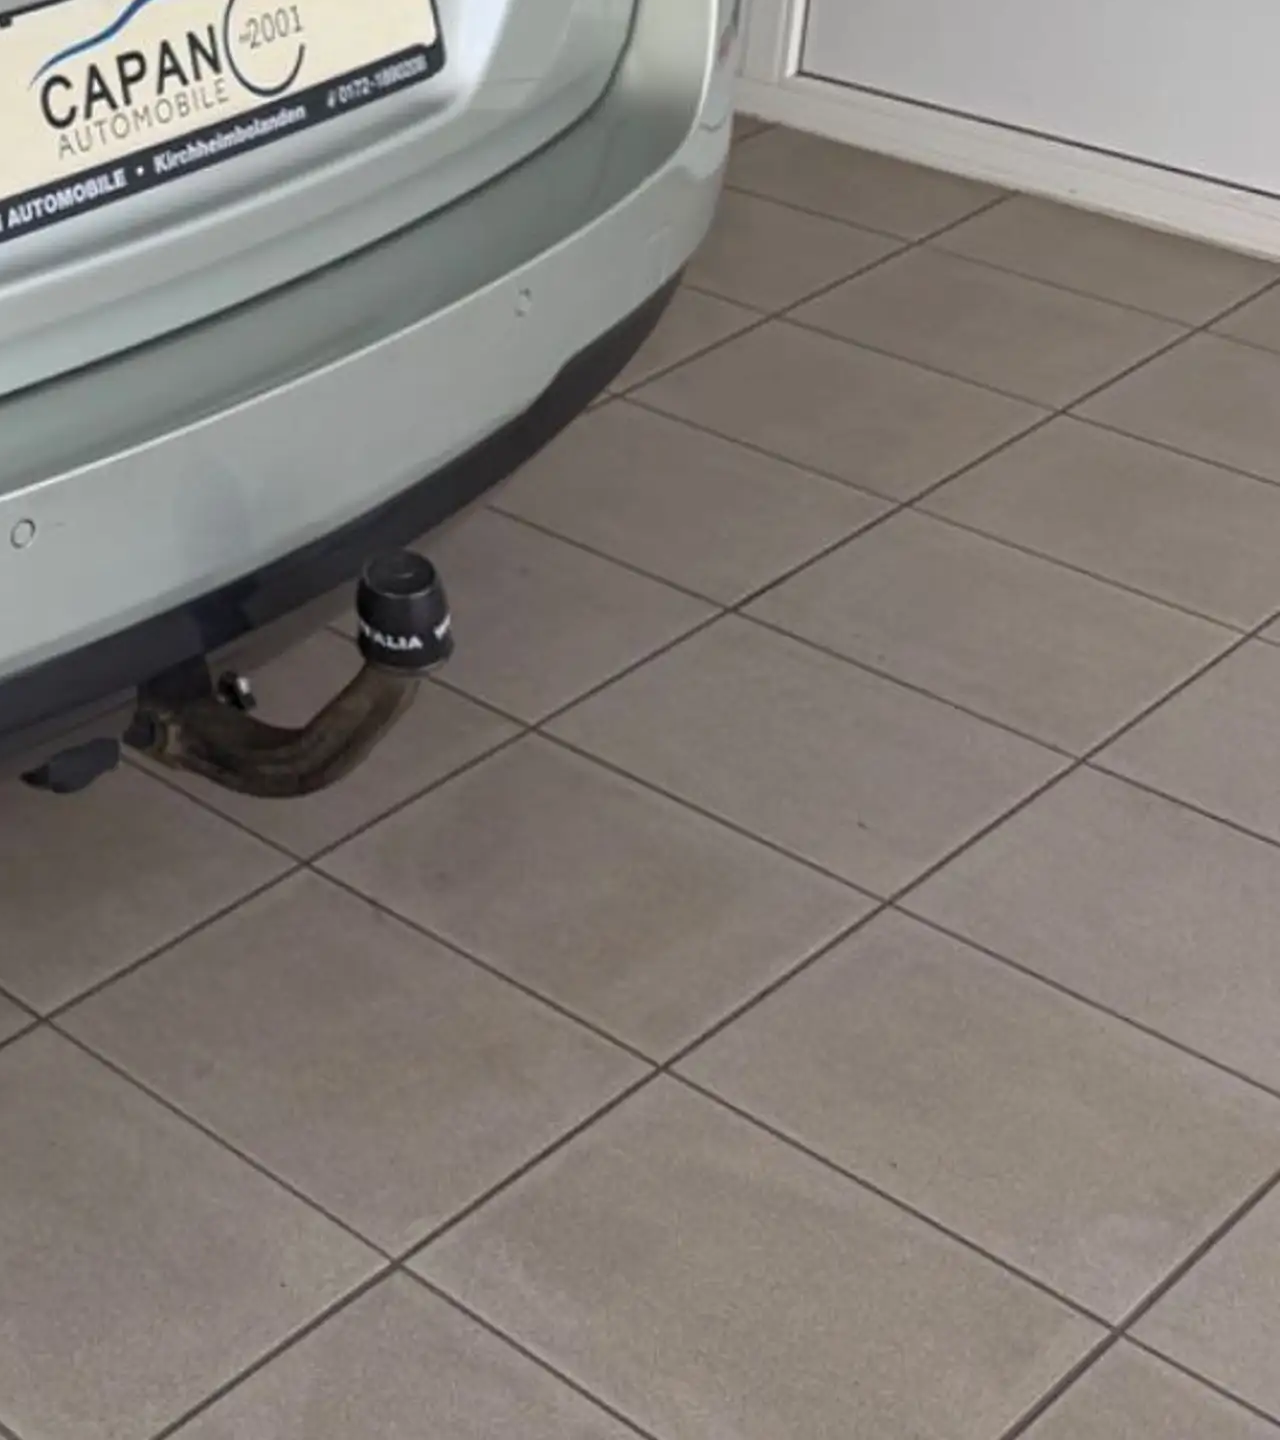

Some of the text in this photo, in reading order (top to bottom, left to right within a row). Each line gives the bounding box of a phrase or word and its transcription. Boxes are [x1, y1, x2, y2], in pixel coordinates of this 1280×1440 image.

[40, 23, 222, 130] CAPAN
[57, 78, 230, 160] AUTOMOBILE
[6, 166, 129, 229] AUTOMOBILE
[153, 102, 306, 175] Kirchheimbolanden
